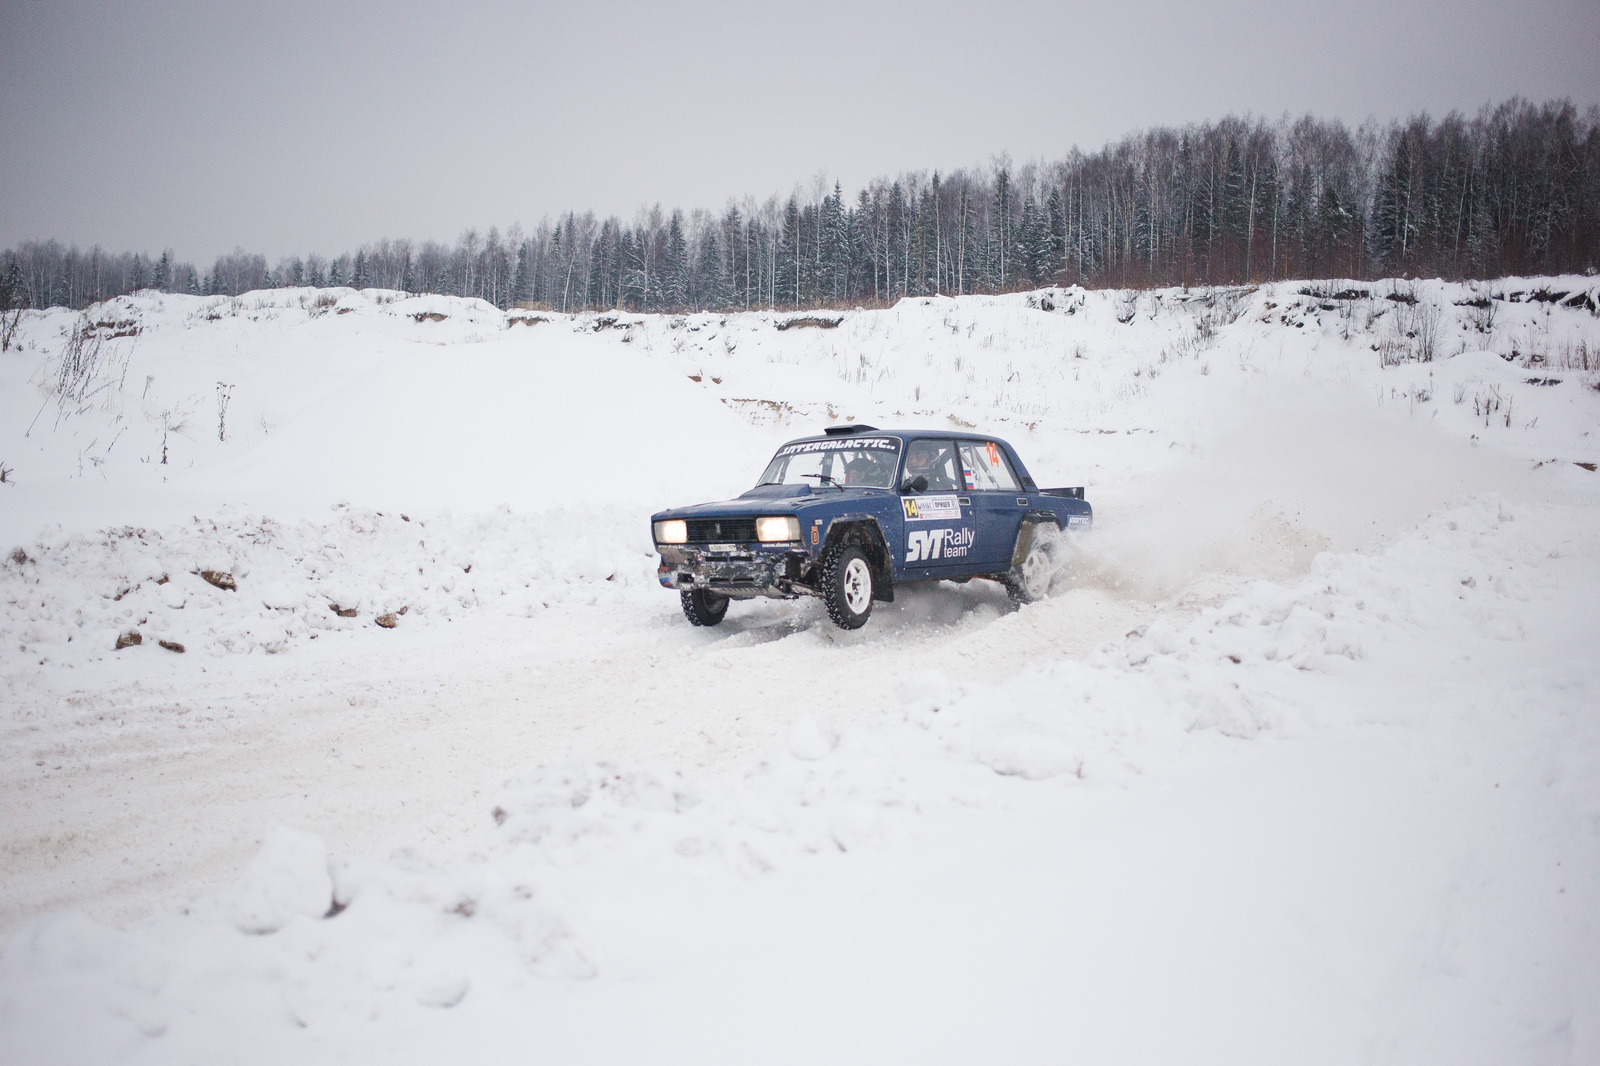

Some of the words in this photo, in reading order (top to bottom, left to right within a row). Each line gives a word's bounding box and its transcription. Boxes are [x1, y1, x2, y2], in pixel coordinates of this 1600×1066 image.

[986, 441, 999, 467] 14
[905, 499, 919, 517] 14
[905, 528, 945, 562] SVT
[944, 527, 975, 549] Rally
[944, 546, 967, 558] team
